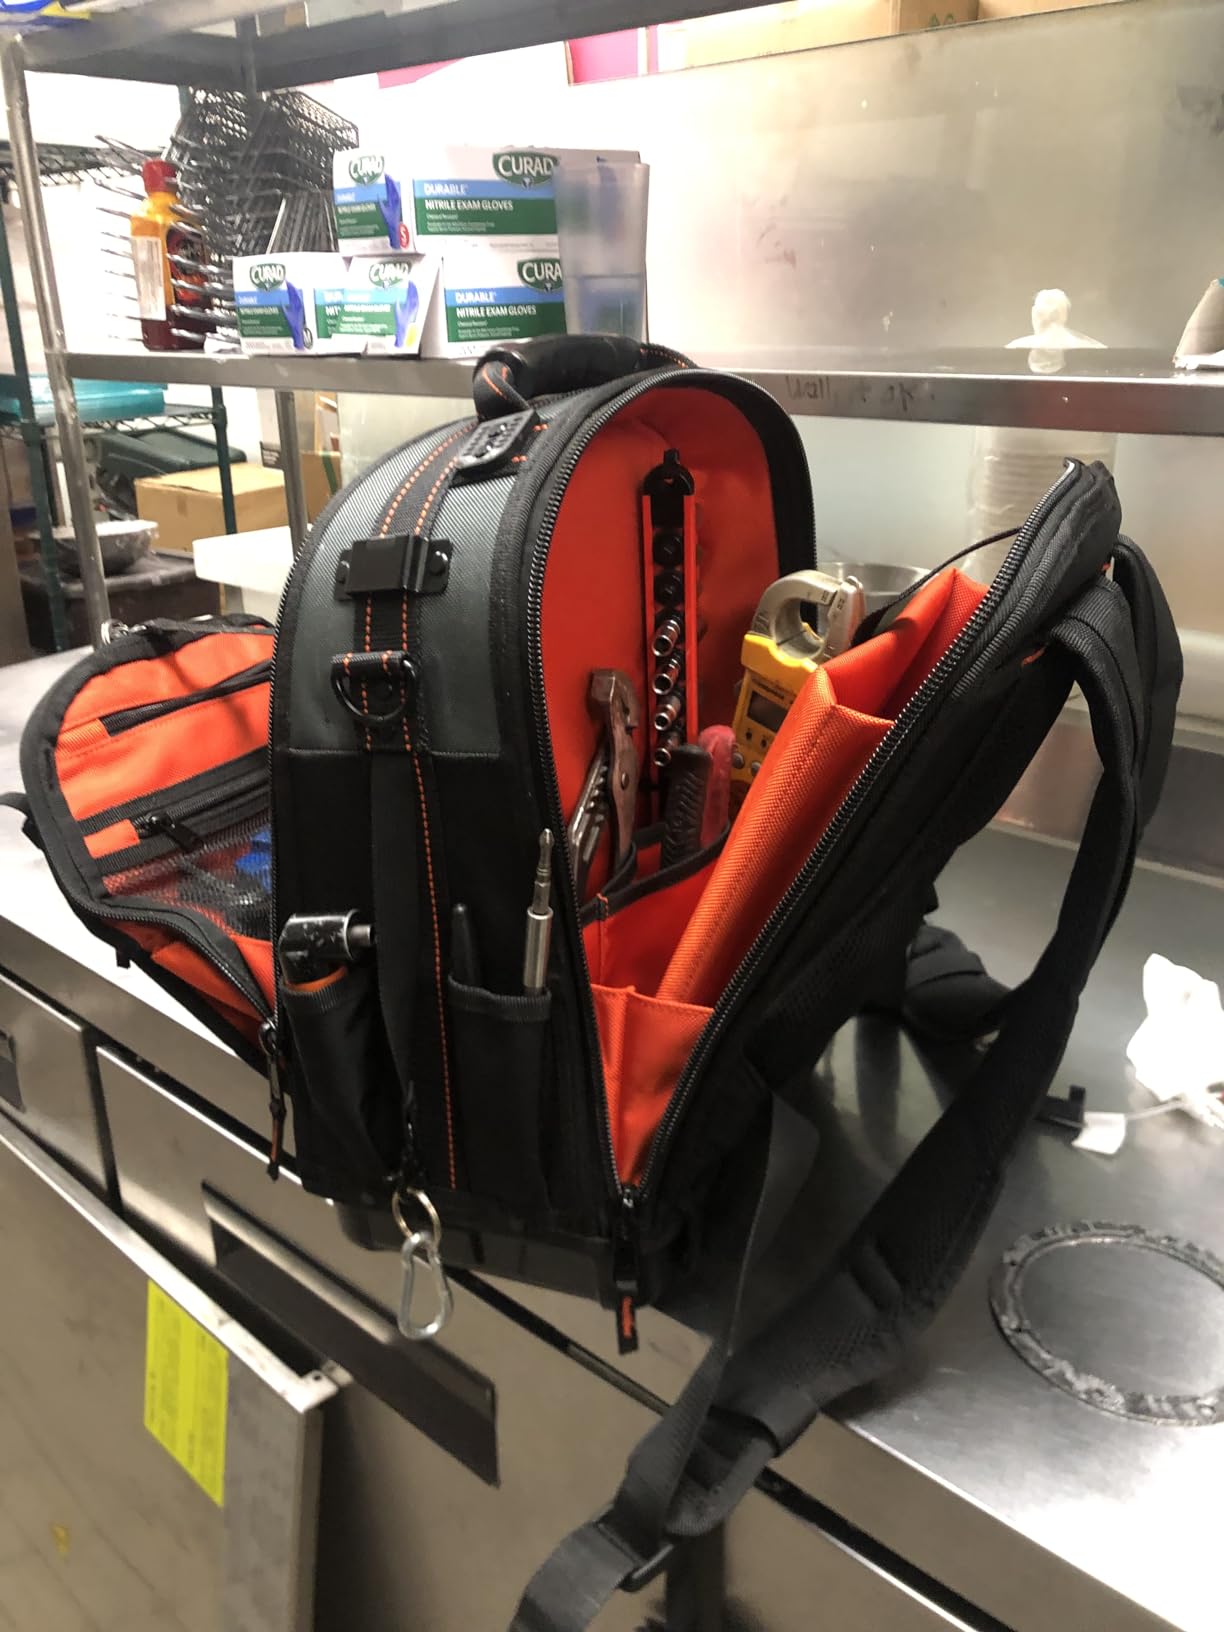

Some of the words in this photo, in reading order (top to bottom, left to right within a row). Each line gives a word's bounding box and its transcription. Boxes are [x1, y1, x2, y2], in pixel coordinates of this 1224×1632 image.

[498, 154, 554, 178] CURAD
[424, 183, 466, 196] DURABLE
[425, 199, 456, 211] NITRILE
[457, 199, 480, 210] EXAM
[481, 199, 513, 210] GLOVES
[522, 261, 562, 283] CURA
[455, 291, 495, 304] DURABLE
[456, 306, 485, 318] NITRILE
[486, 305, 507, 317] EXAM
[508, 304, 536, 316] GLOVES
